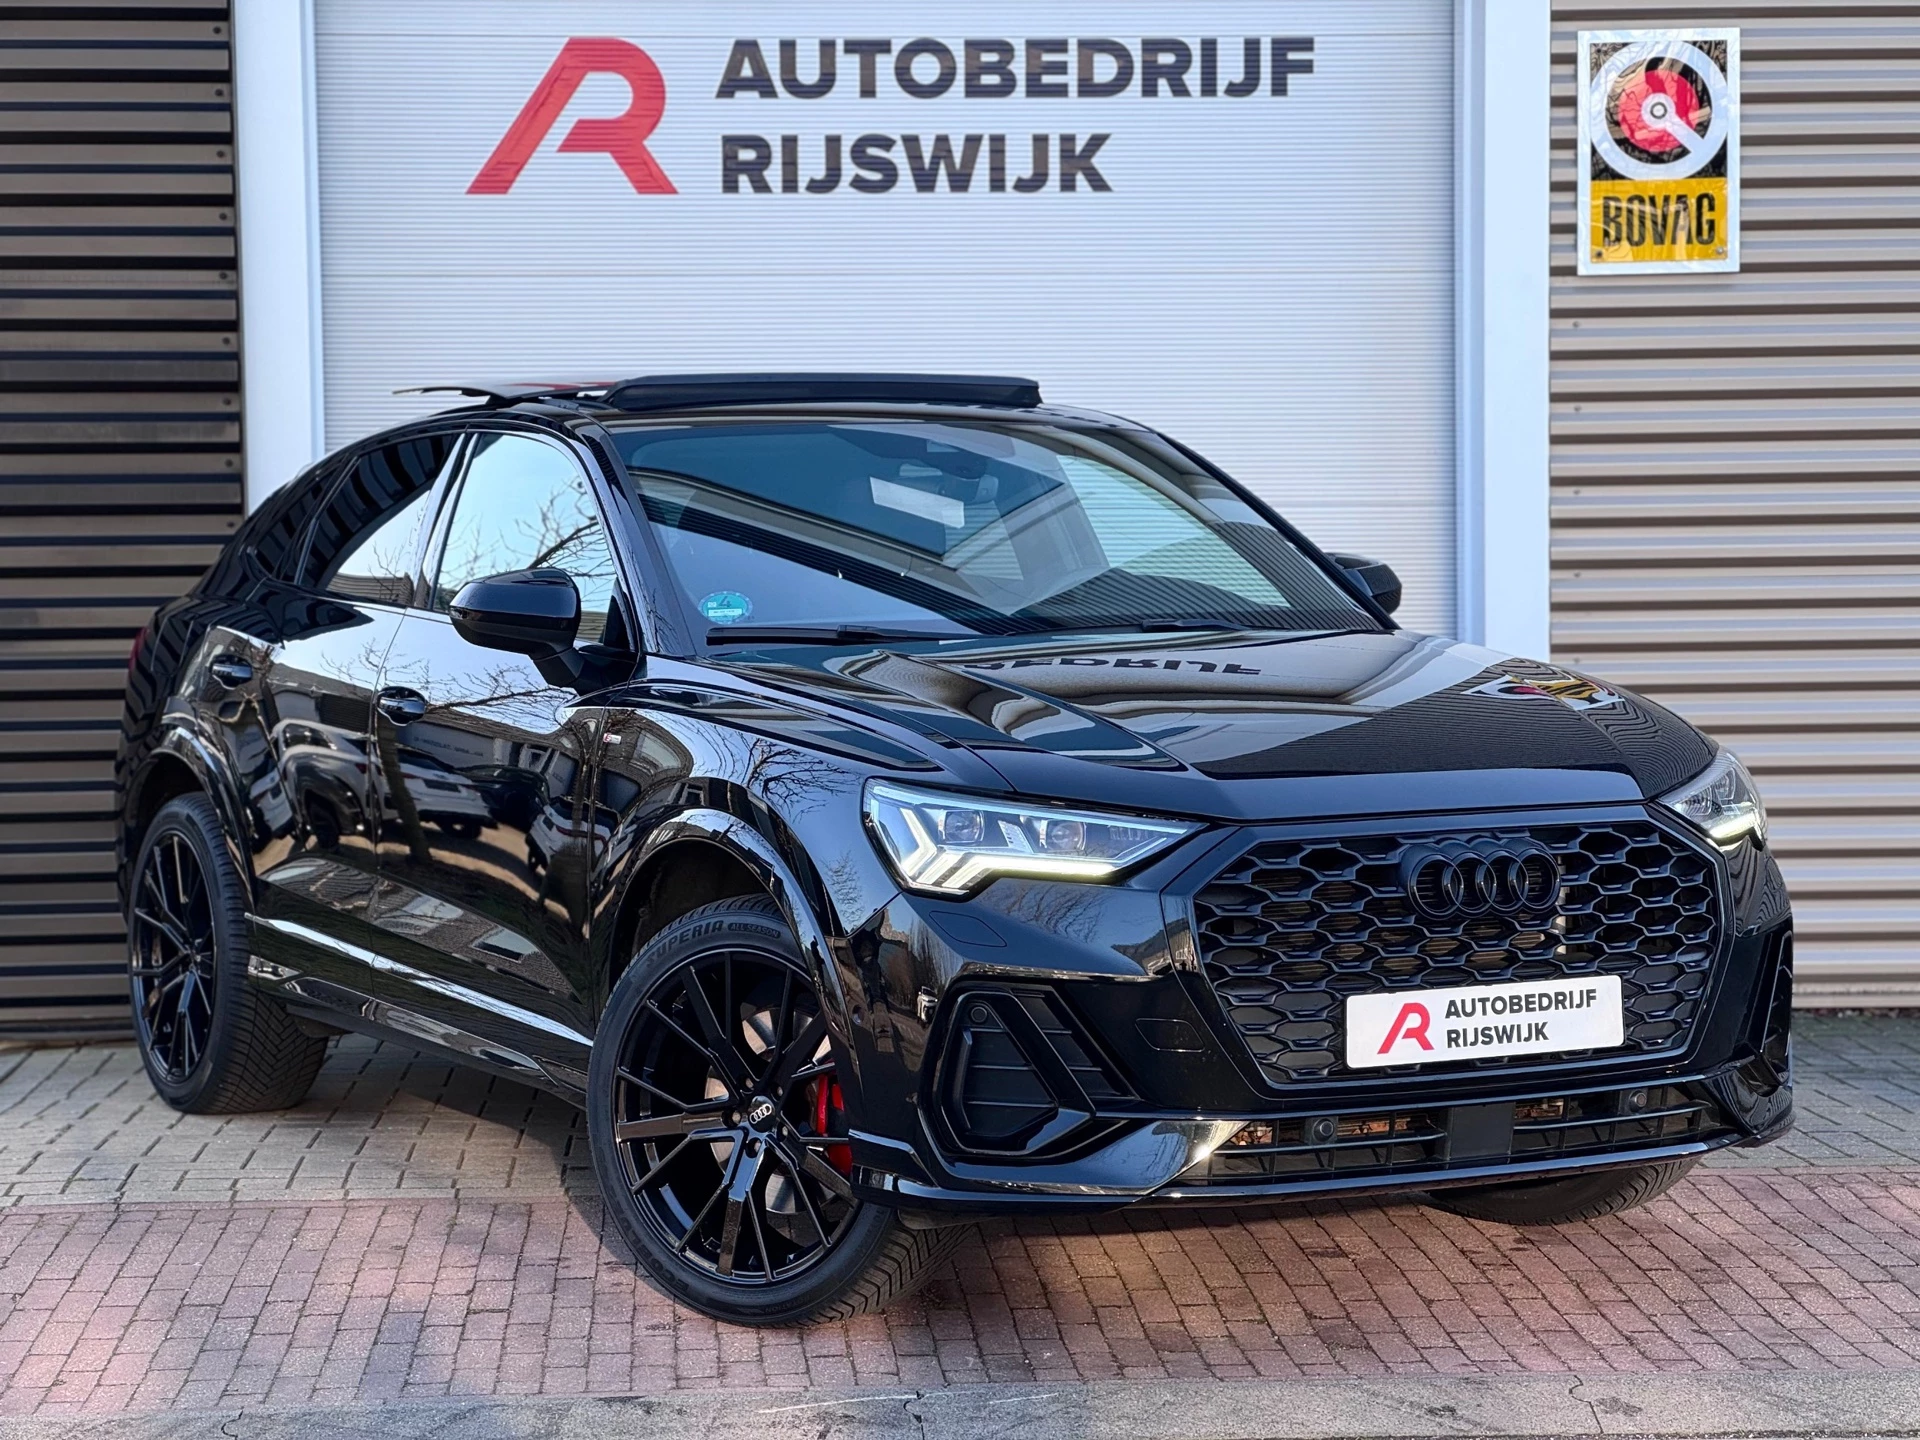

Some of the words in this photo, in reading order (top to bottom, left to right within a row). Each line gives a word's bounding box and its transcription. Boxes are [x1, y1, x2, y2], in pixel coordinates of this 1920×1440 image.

[715, 37, 1315, 99] AUTOBEDRIJF
[721, 134, 1113, 195] RIJSWIJK
[1602, 192, 1716, 247] BOVAG
[646, 920, 724, 966] SUPERIA
[747, 924, 779, 938] SEASON
[1445, 988, 1597, 1019] AUTOBEDRIJF
[1446, 1022, 1549, 1049] RIJSWIJK
